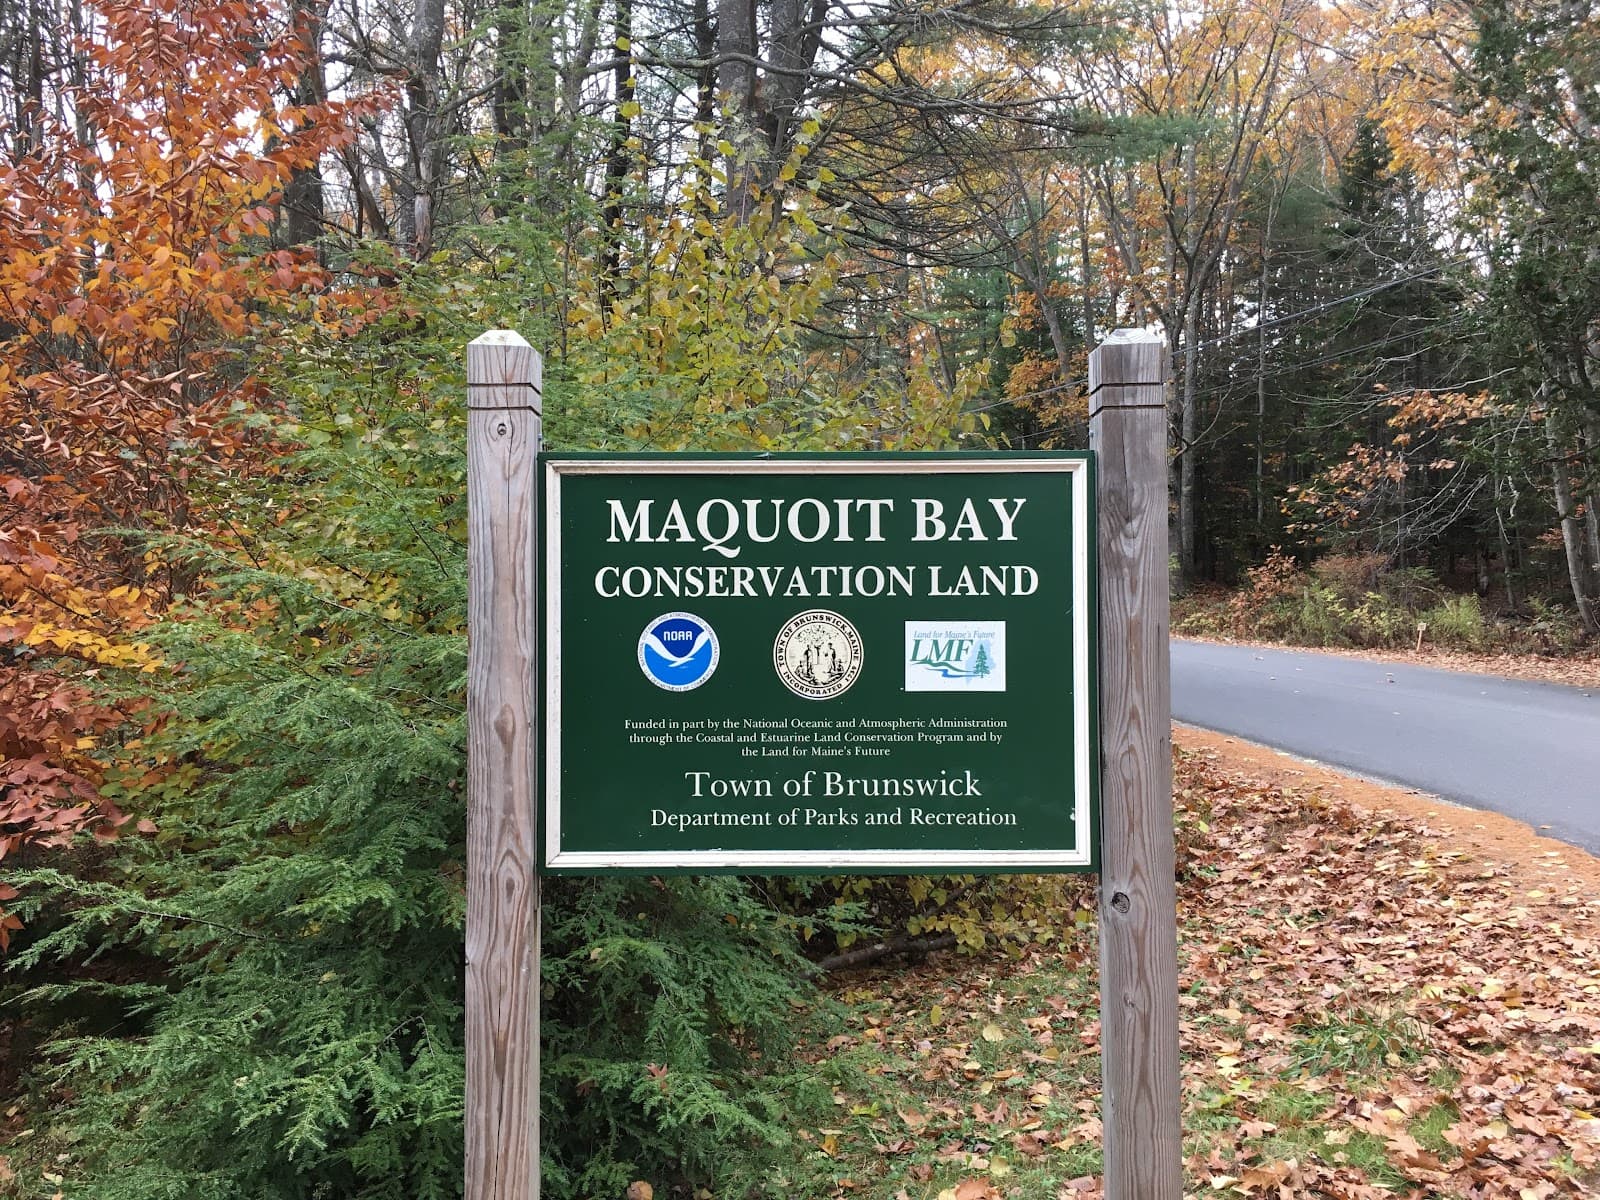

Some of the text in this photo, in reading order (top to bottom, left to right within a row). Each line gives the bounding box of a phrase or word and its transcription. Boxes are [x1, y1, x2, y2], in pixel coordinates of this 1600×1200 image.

[606, 498, 1027, 559] MAQUOIT BAY
[594, 565, 1039, 598] CONSERVATION LAND
[913, 630, 931, 639] Land
[933, 630, 942, 638] for
[944, 631, 971, 639] Maine's
[777, 640, 786, 667] TOWN
[784, 628, 793, 638] OF
[910, 639, 973, 661] LMF
[783, 672, 843, 694] INCORPORATED
[624, 718, 1008, 732] Funded in part by the National Oceanic and Atmospheric Administration
[629, 732, 1003, 745] through the Coastal and Estuarine Land Conservation Program and by
[741, 746, 891, 757] the Land for Maine's Future
[685, 770, 982, 798] Town of Brunswick
[651, 807, 1017, 832] Department of Parks and Recreation
